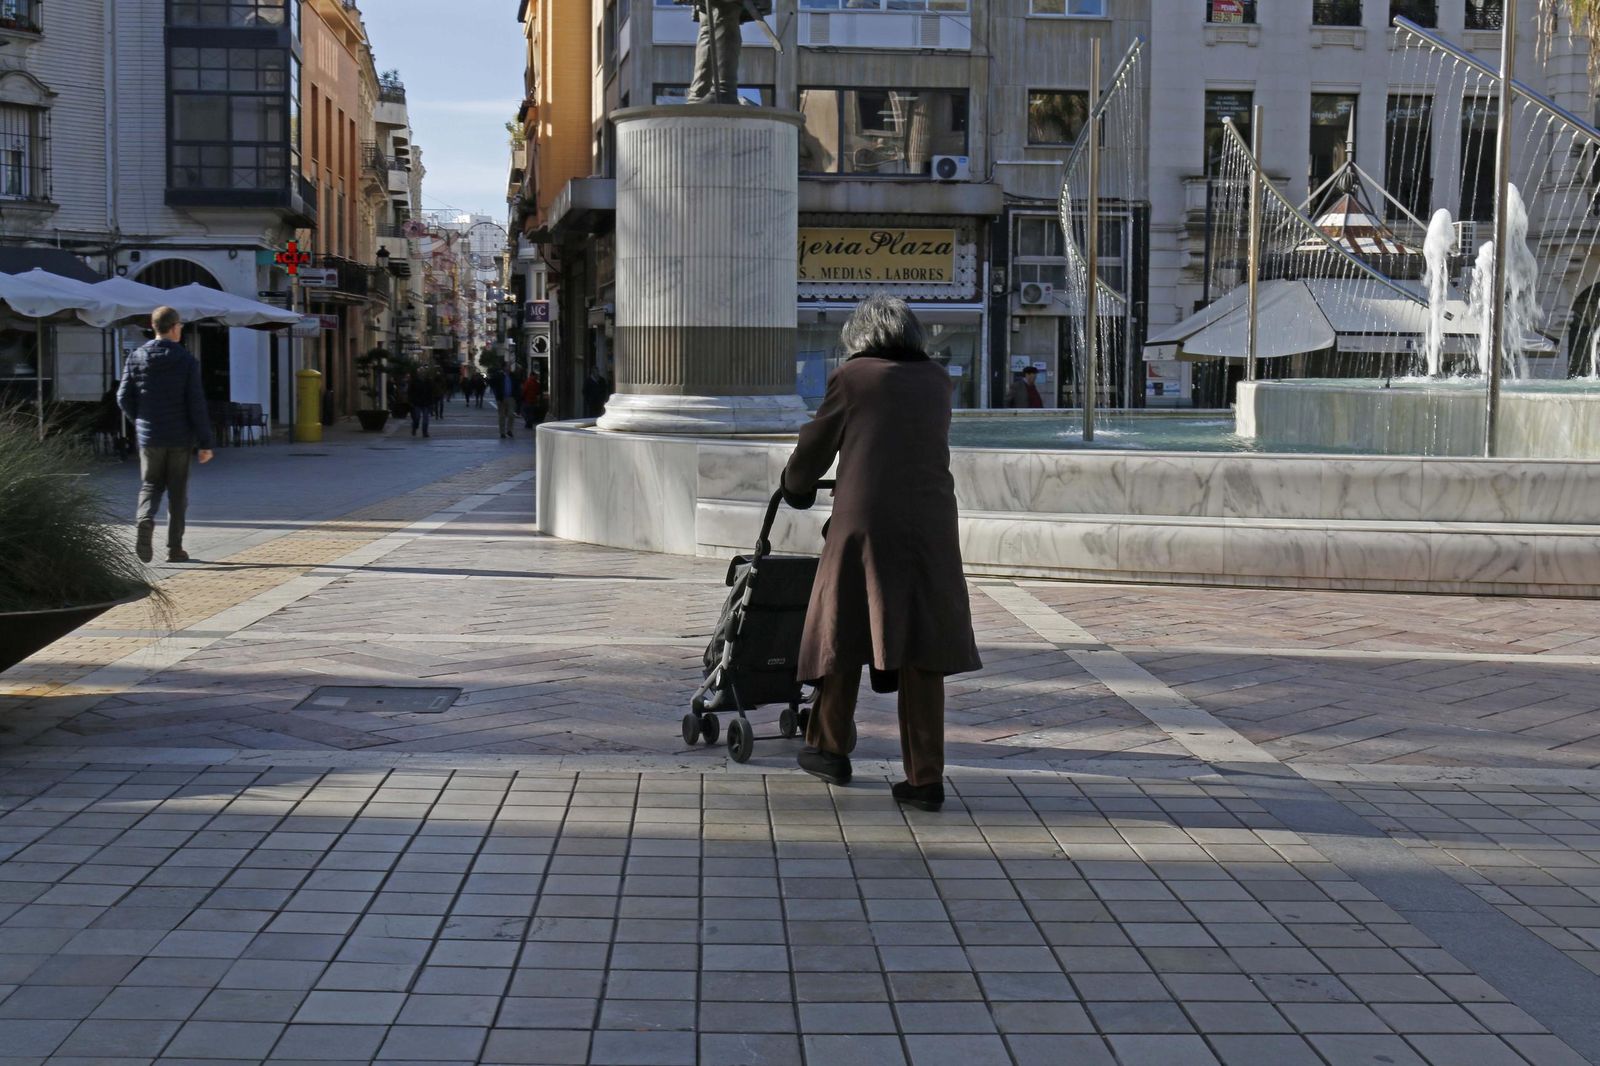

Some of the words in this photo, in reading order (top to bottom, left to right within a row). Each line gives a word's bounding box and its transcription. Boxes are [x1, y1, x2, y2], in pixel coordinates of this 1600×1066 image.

[865, 231, 953, 255] Plaza
[821, 268, 872, 280] MEDIAS
[886, 268, 943, 280] LABORES
